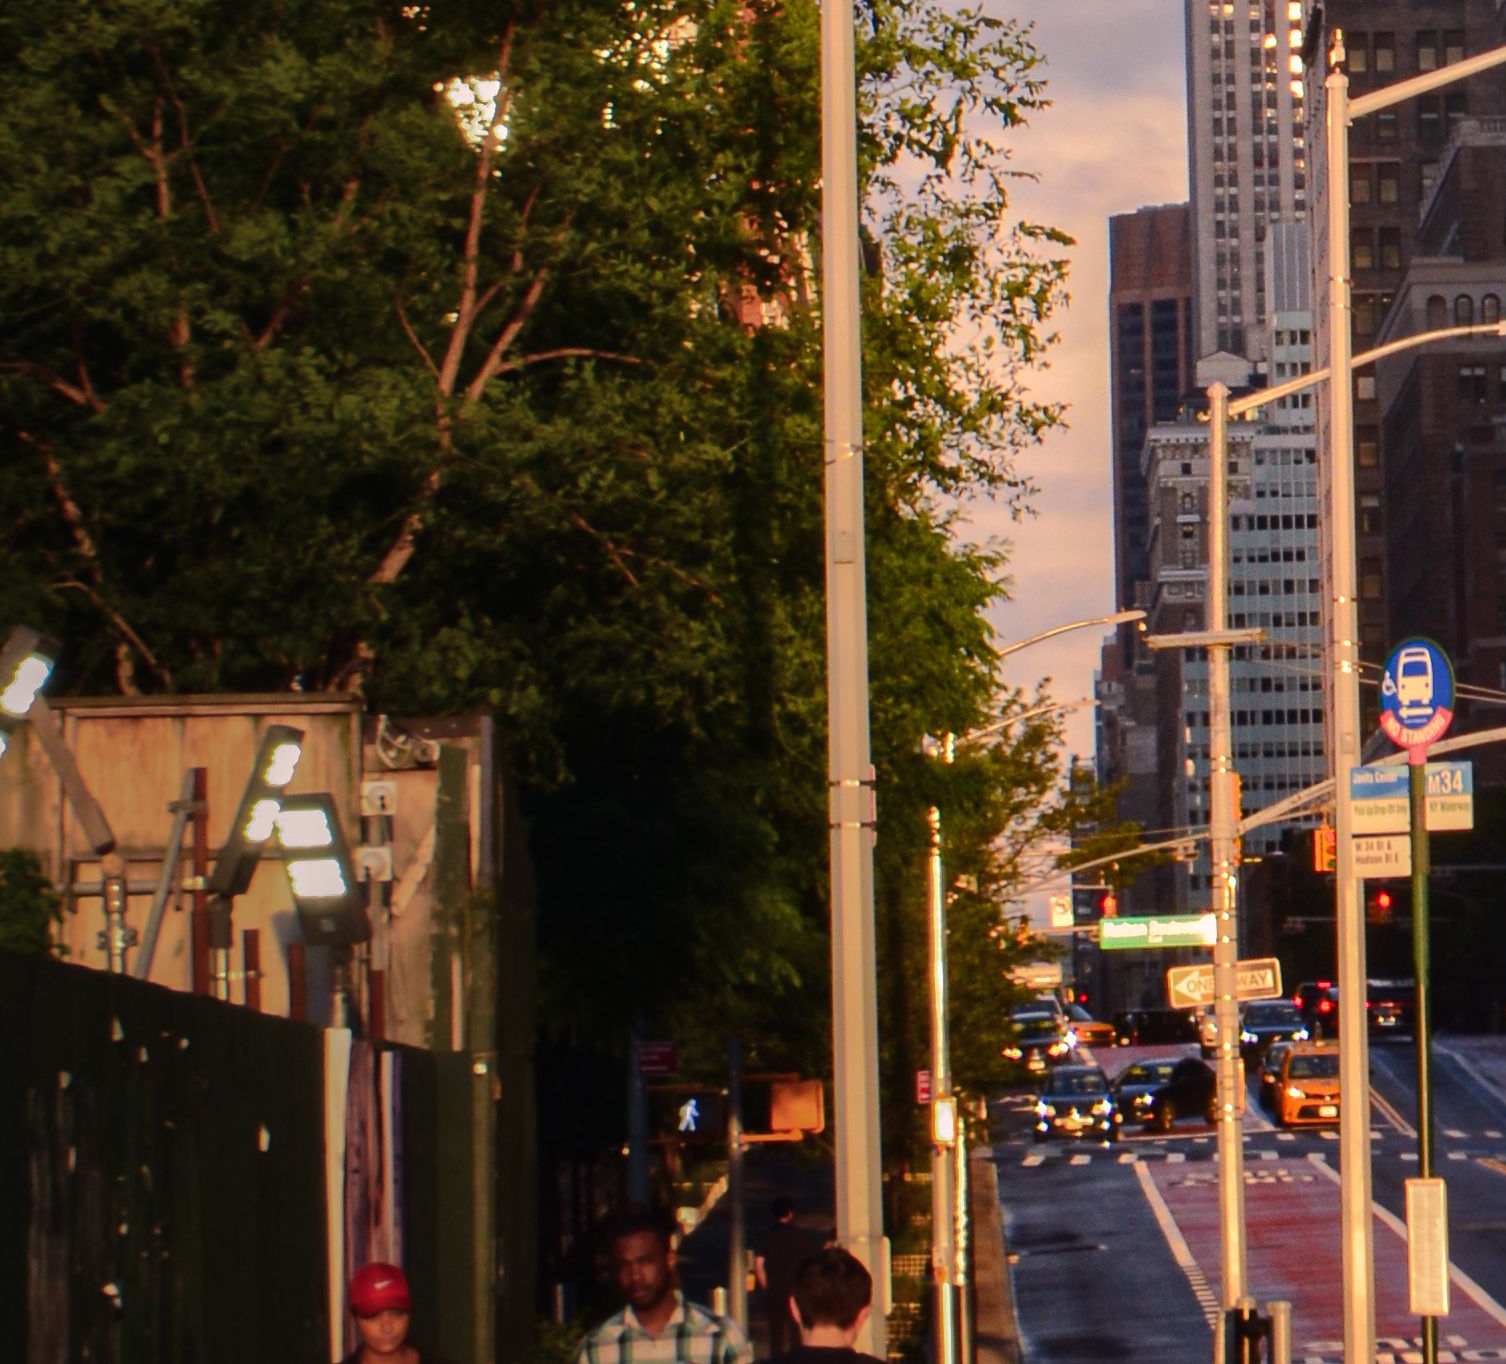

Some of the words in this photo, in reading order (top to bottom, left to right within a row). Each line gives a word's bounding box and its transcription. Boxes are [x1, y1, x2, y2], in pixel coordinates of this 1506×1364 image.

[1400, 713, 1446, 745] STANDING
[1428, 770, 1463, 793] M34
[1186, 975, 1215, 993] ONE
[1237, 972, 1269, 989] WAY
